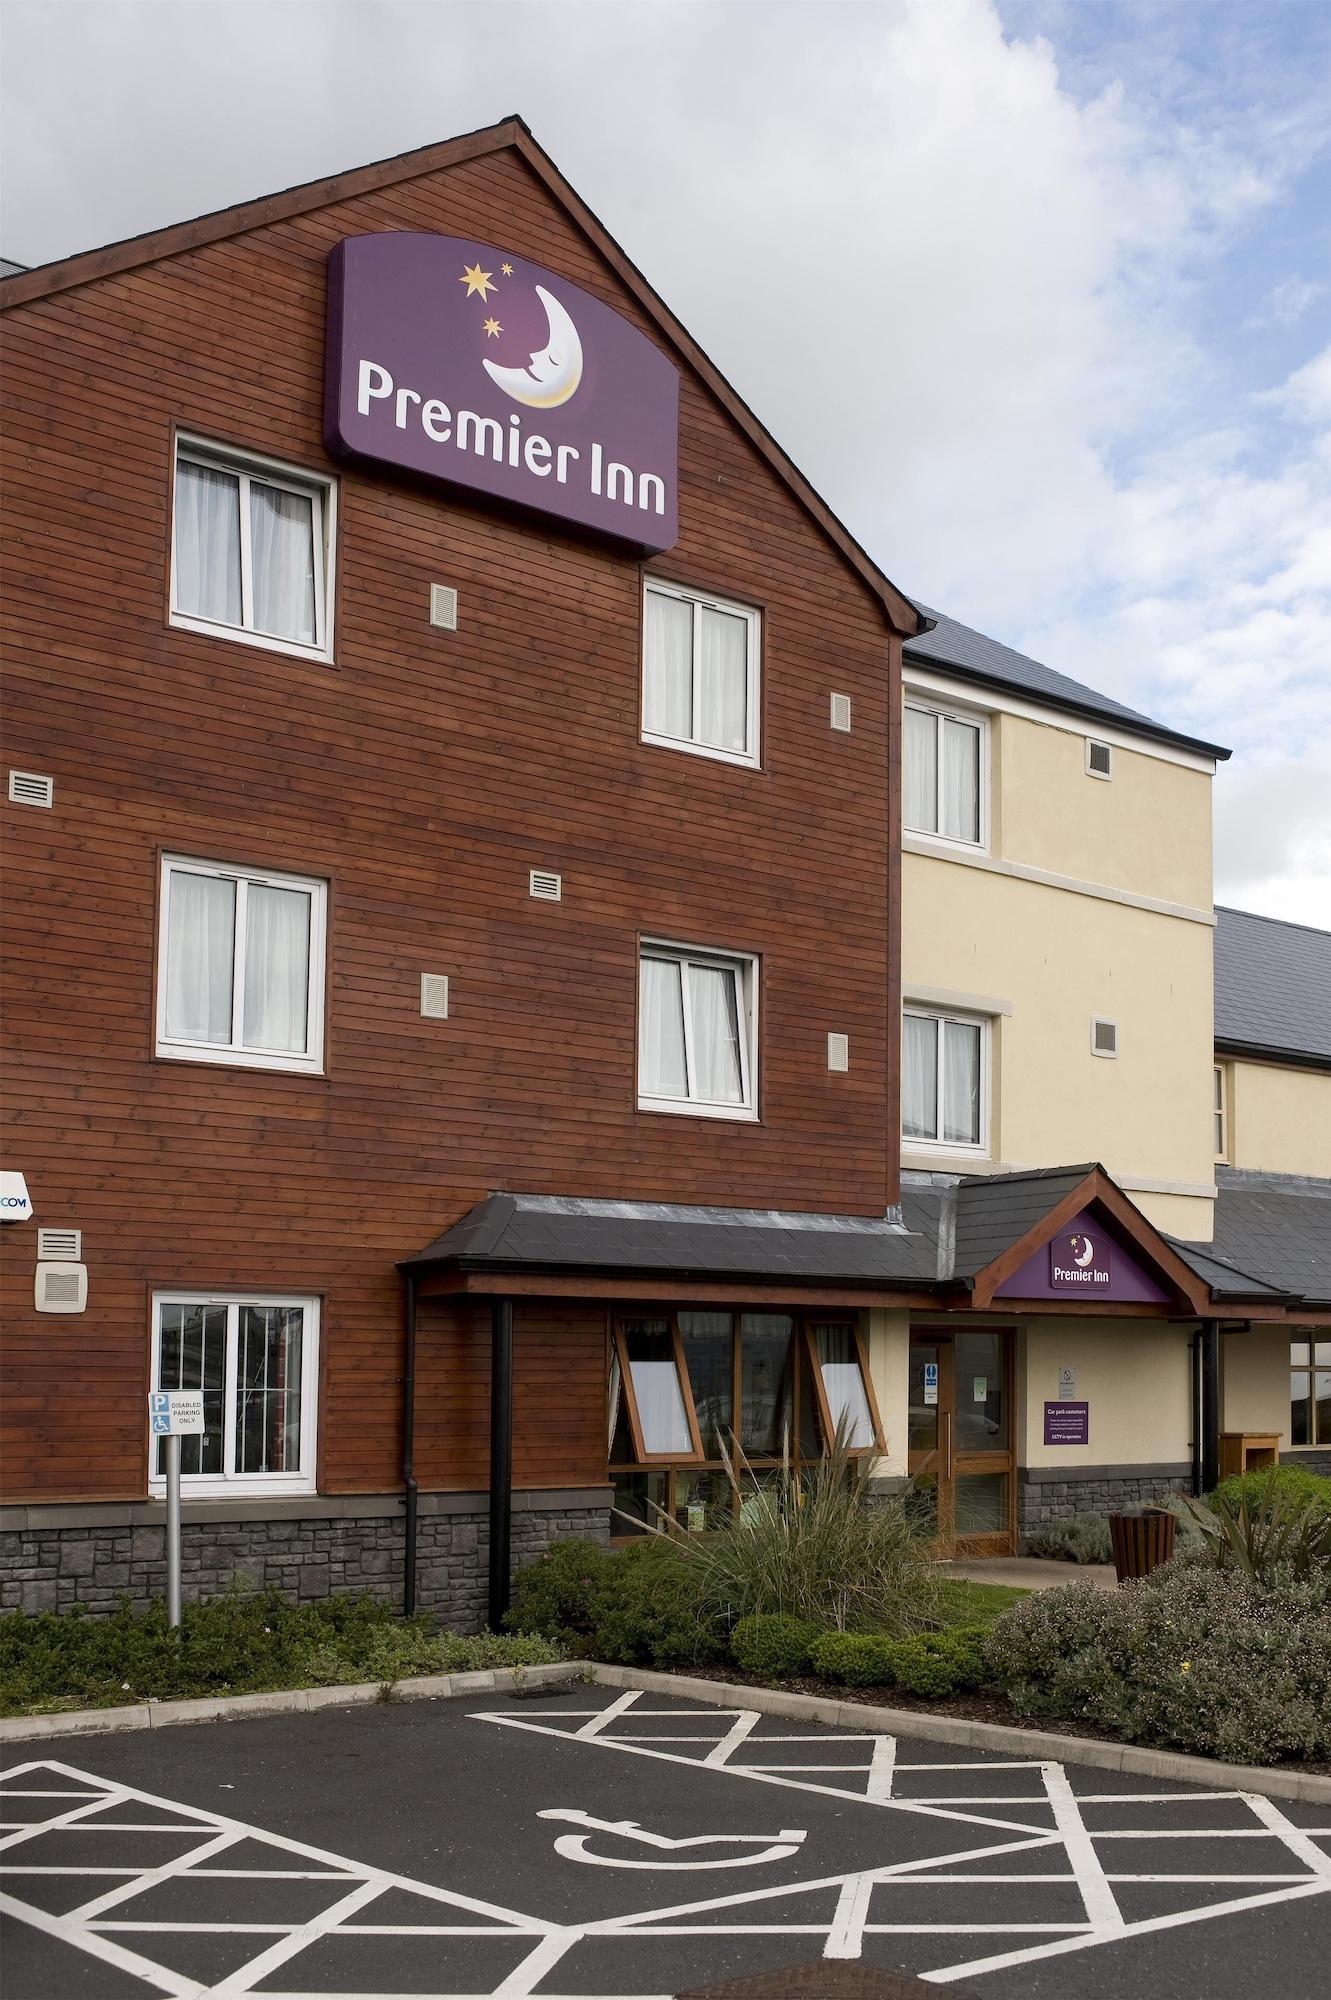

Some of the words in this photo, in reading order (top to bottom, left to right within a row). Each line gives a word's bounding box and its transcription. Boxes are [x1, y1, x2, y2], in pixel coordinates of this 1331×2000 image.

[357, 359, 580, 484] Premier
[590, 443, 665, 515] Inn
[1054, 1267, 1093, 1282] Premier
[1093, 1269, 1109, 1282] Inn
[154, 1395, 166, 1411] P
